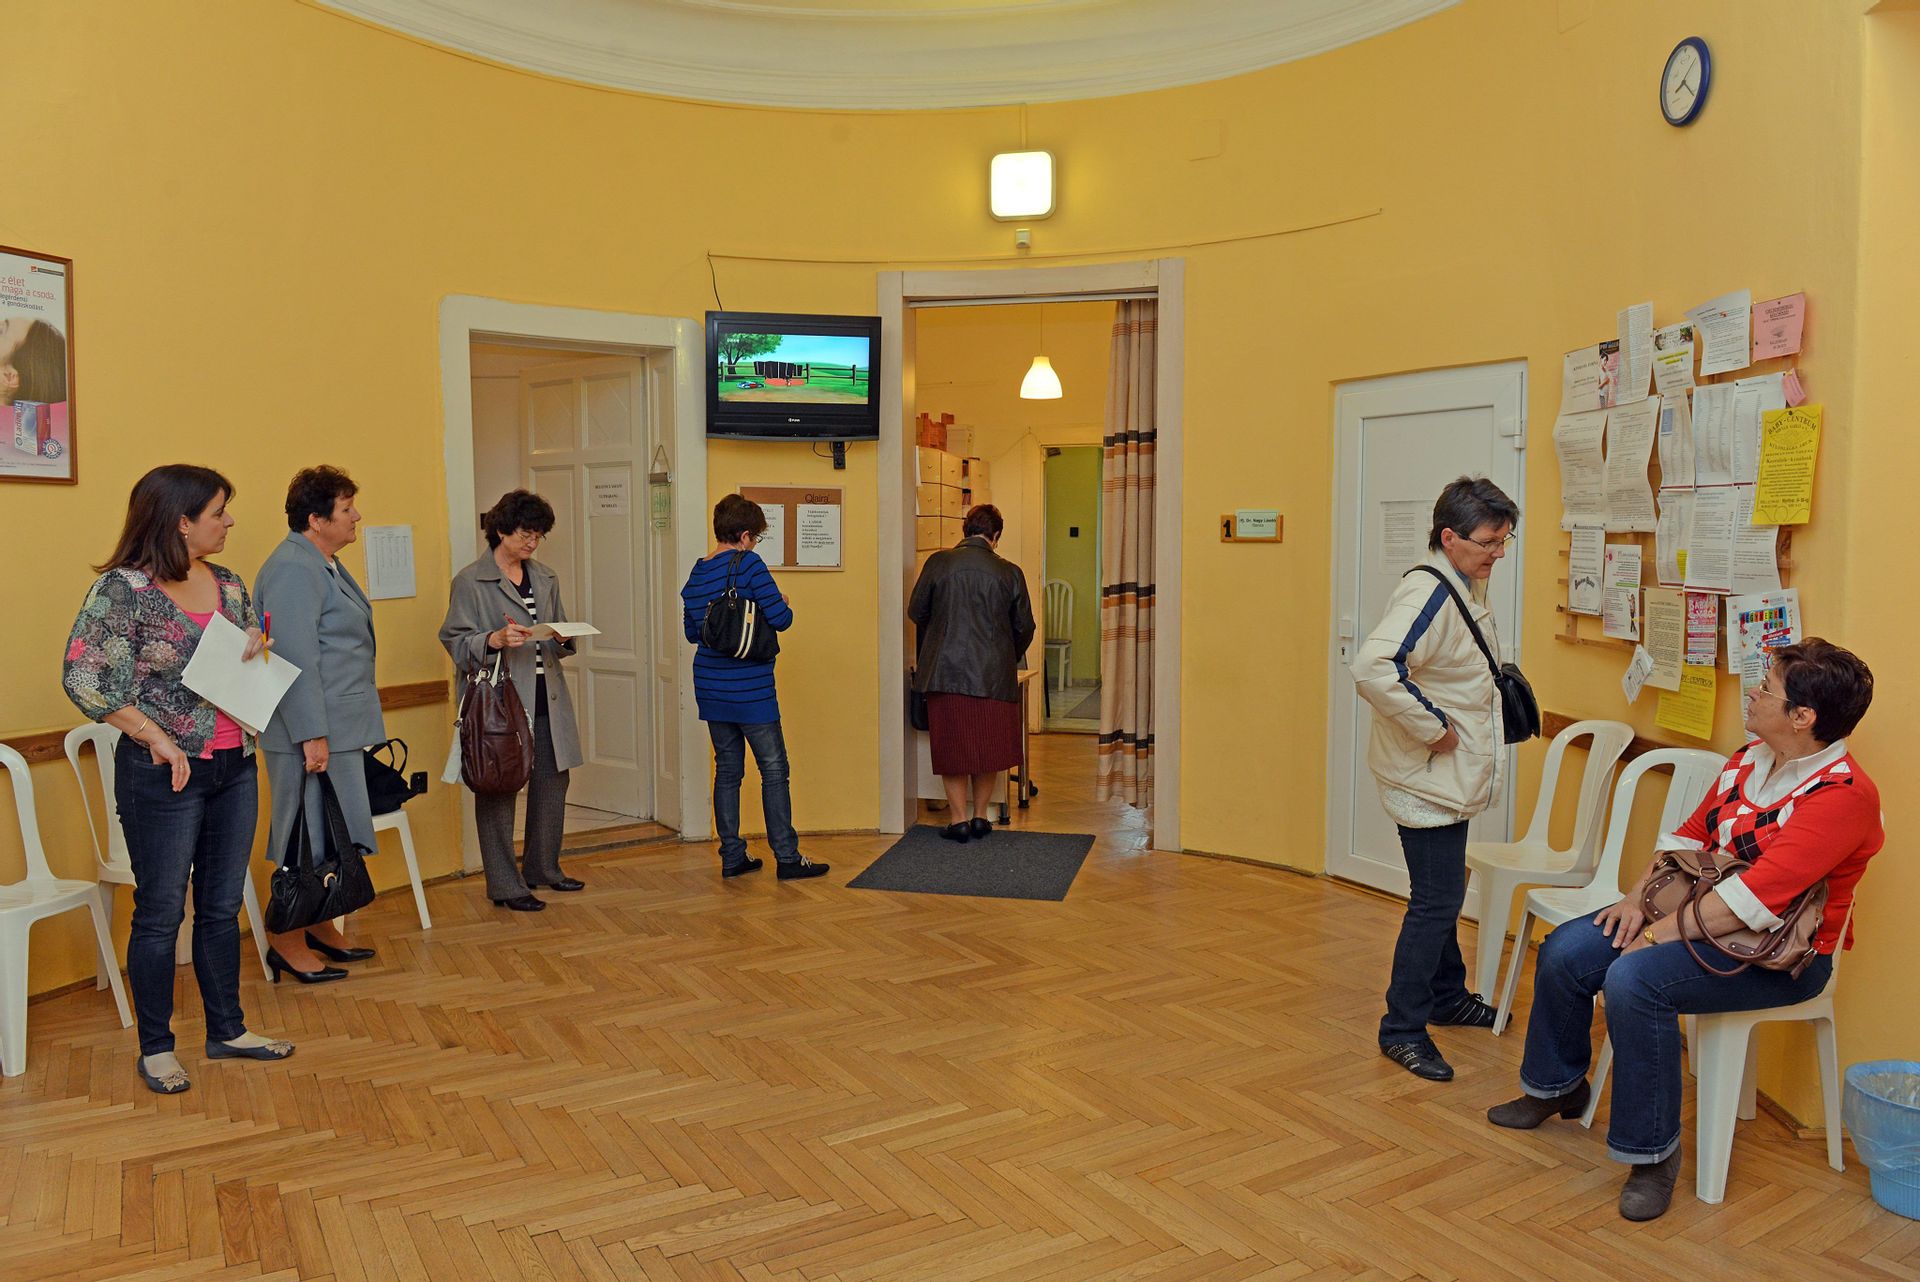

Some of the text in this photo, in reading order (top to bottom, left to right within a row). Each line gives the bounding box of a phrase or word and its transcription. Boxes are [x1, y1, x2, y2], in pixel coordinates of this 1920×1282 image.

[8, 276, 25, 287] élet
[2, 285, 23, 297] maga
[1223, 519, 1232, 538] 1
